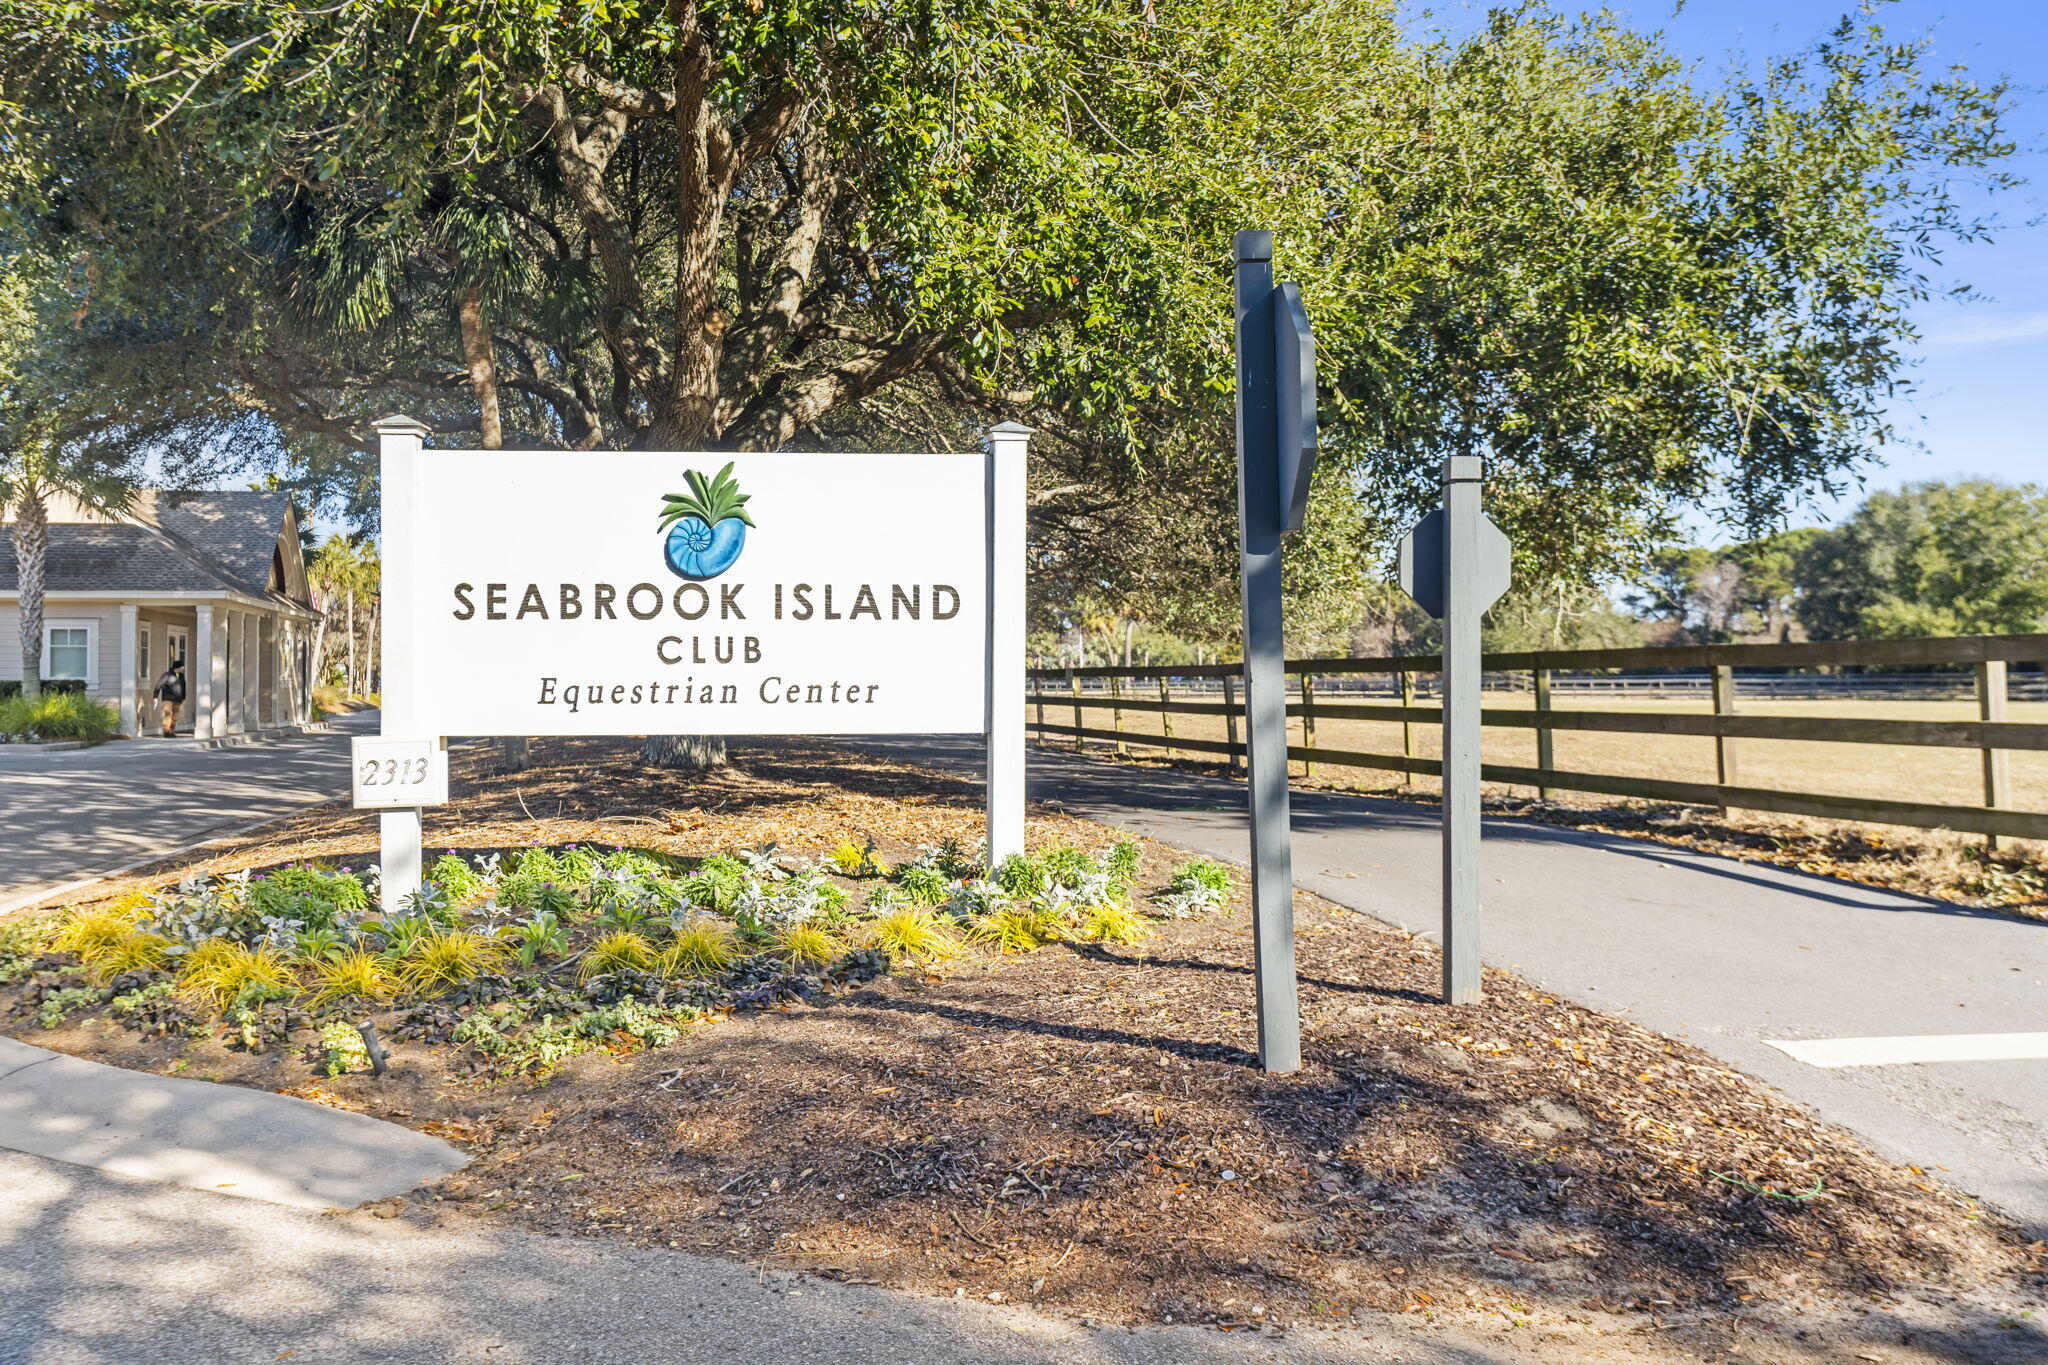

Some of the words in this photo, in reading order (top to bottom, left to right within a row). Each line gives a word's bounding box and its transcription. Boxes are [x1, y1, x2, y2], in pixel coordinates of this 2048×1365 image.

[453, 582, 747, 621] SEABROOK
[774, 583, 961, 621] ISLAND
[656, 635, 762, 665] CLUB
[537, 676, 737, 713] Equestrian
[759, 676, 880, 704] Center
[362, 757, 429, 786] 2313
